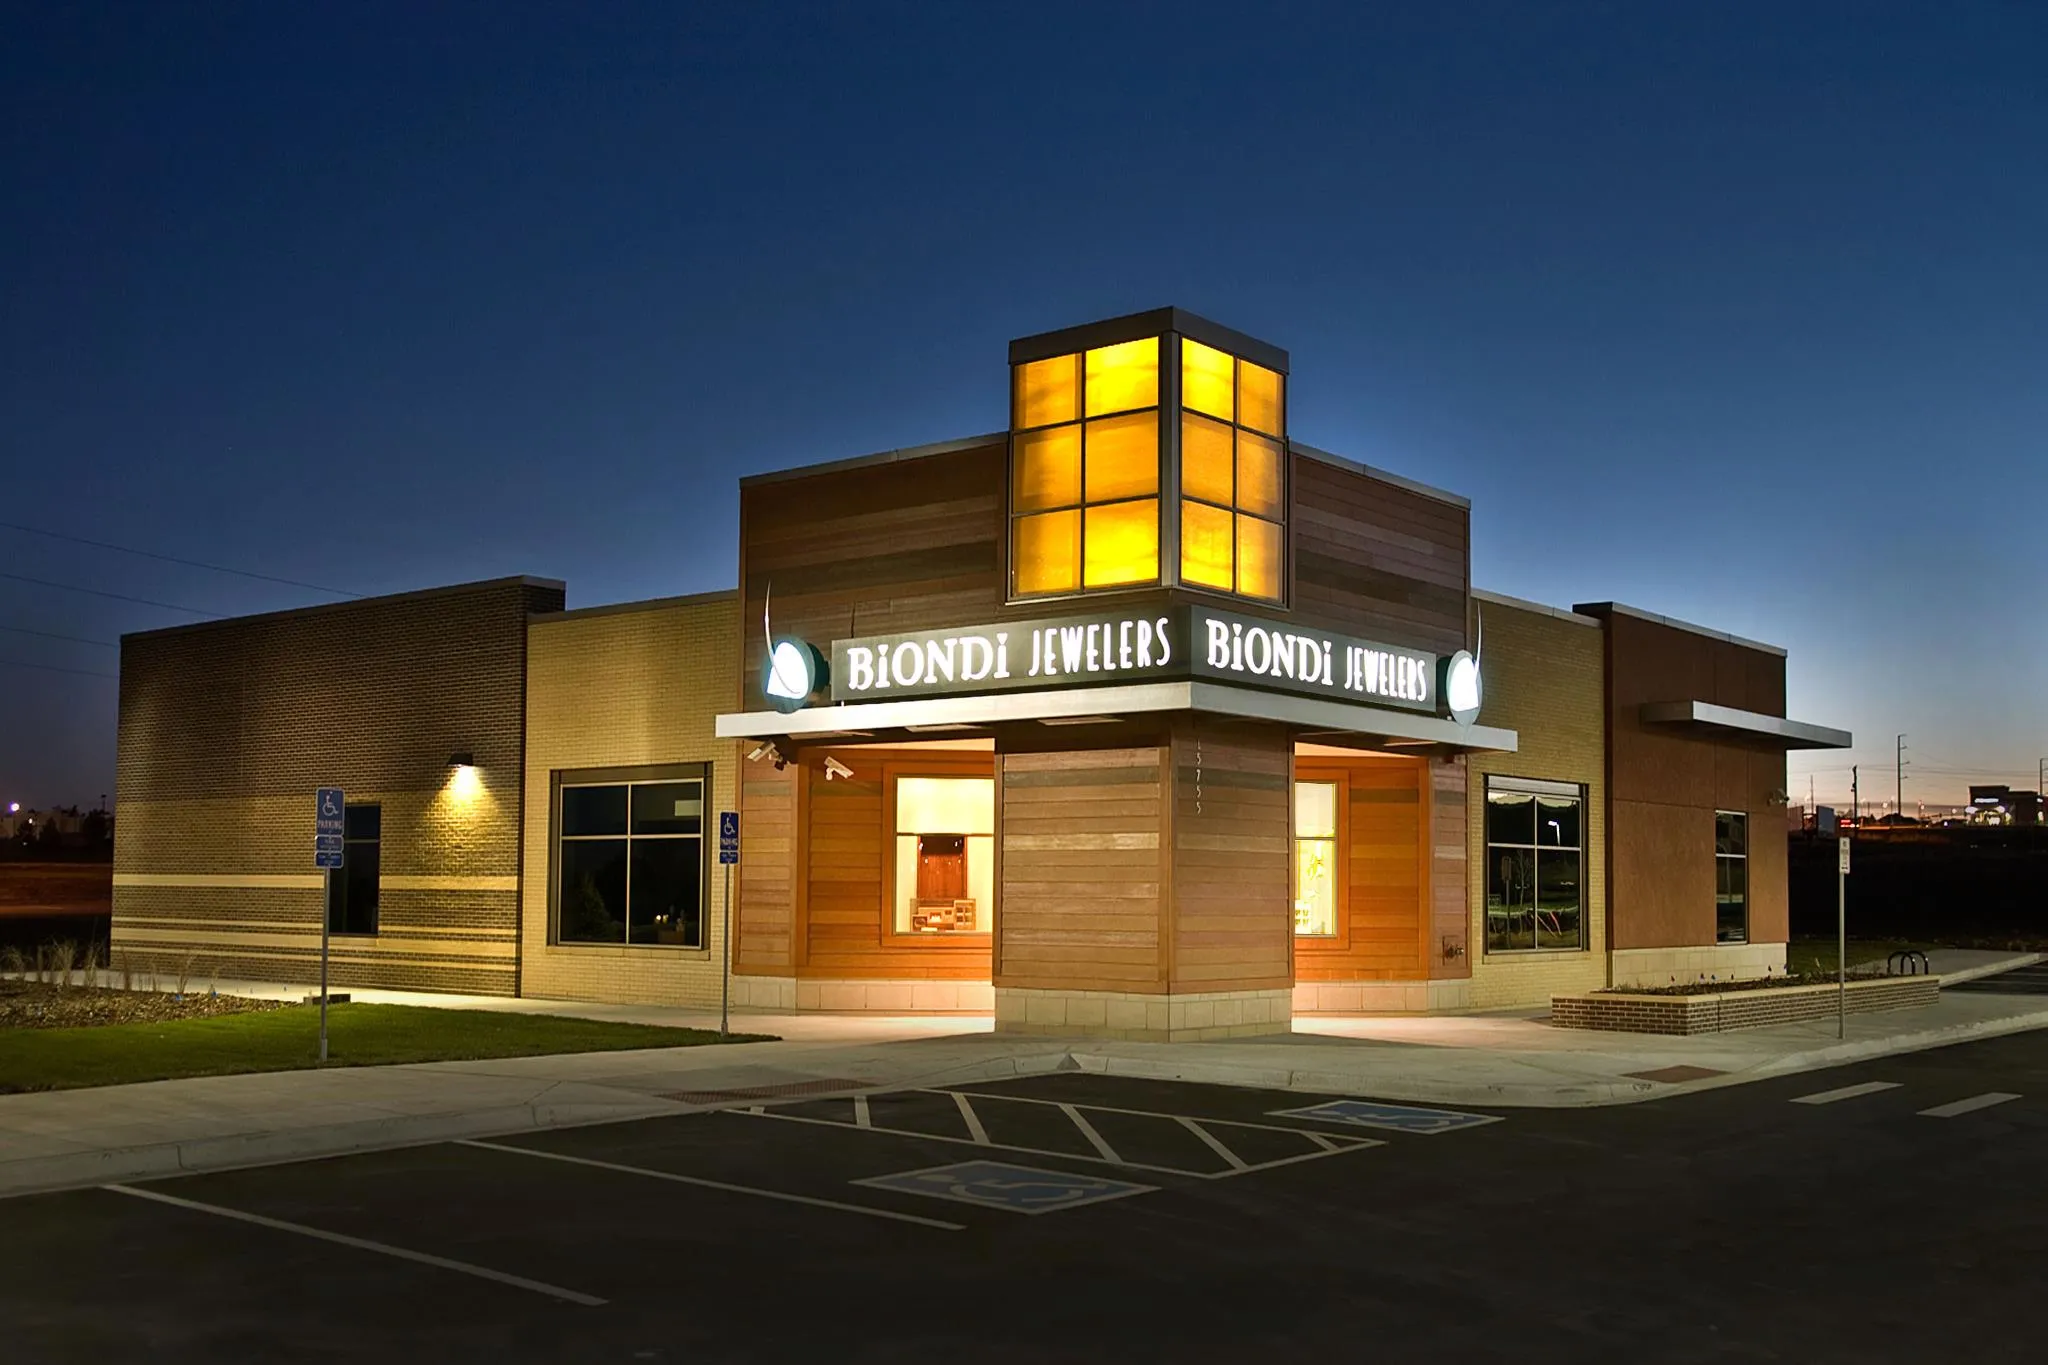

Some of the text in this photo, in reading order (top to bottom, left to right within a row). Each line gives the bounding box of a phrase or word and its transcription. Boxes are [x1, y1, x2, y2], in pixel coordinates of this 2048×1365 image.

[1028, 617, 1172, 677] JEWELERS
[1344, 646, 1427, 701] JEWELERS
[317, 819, 342, 830] PARKING
